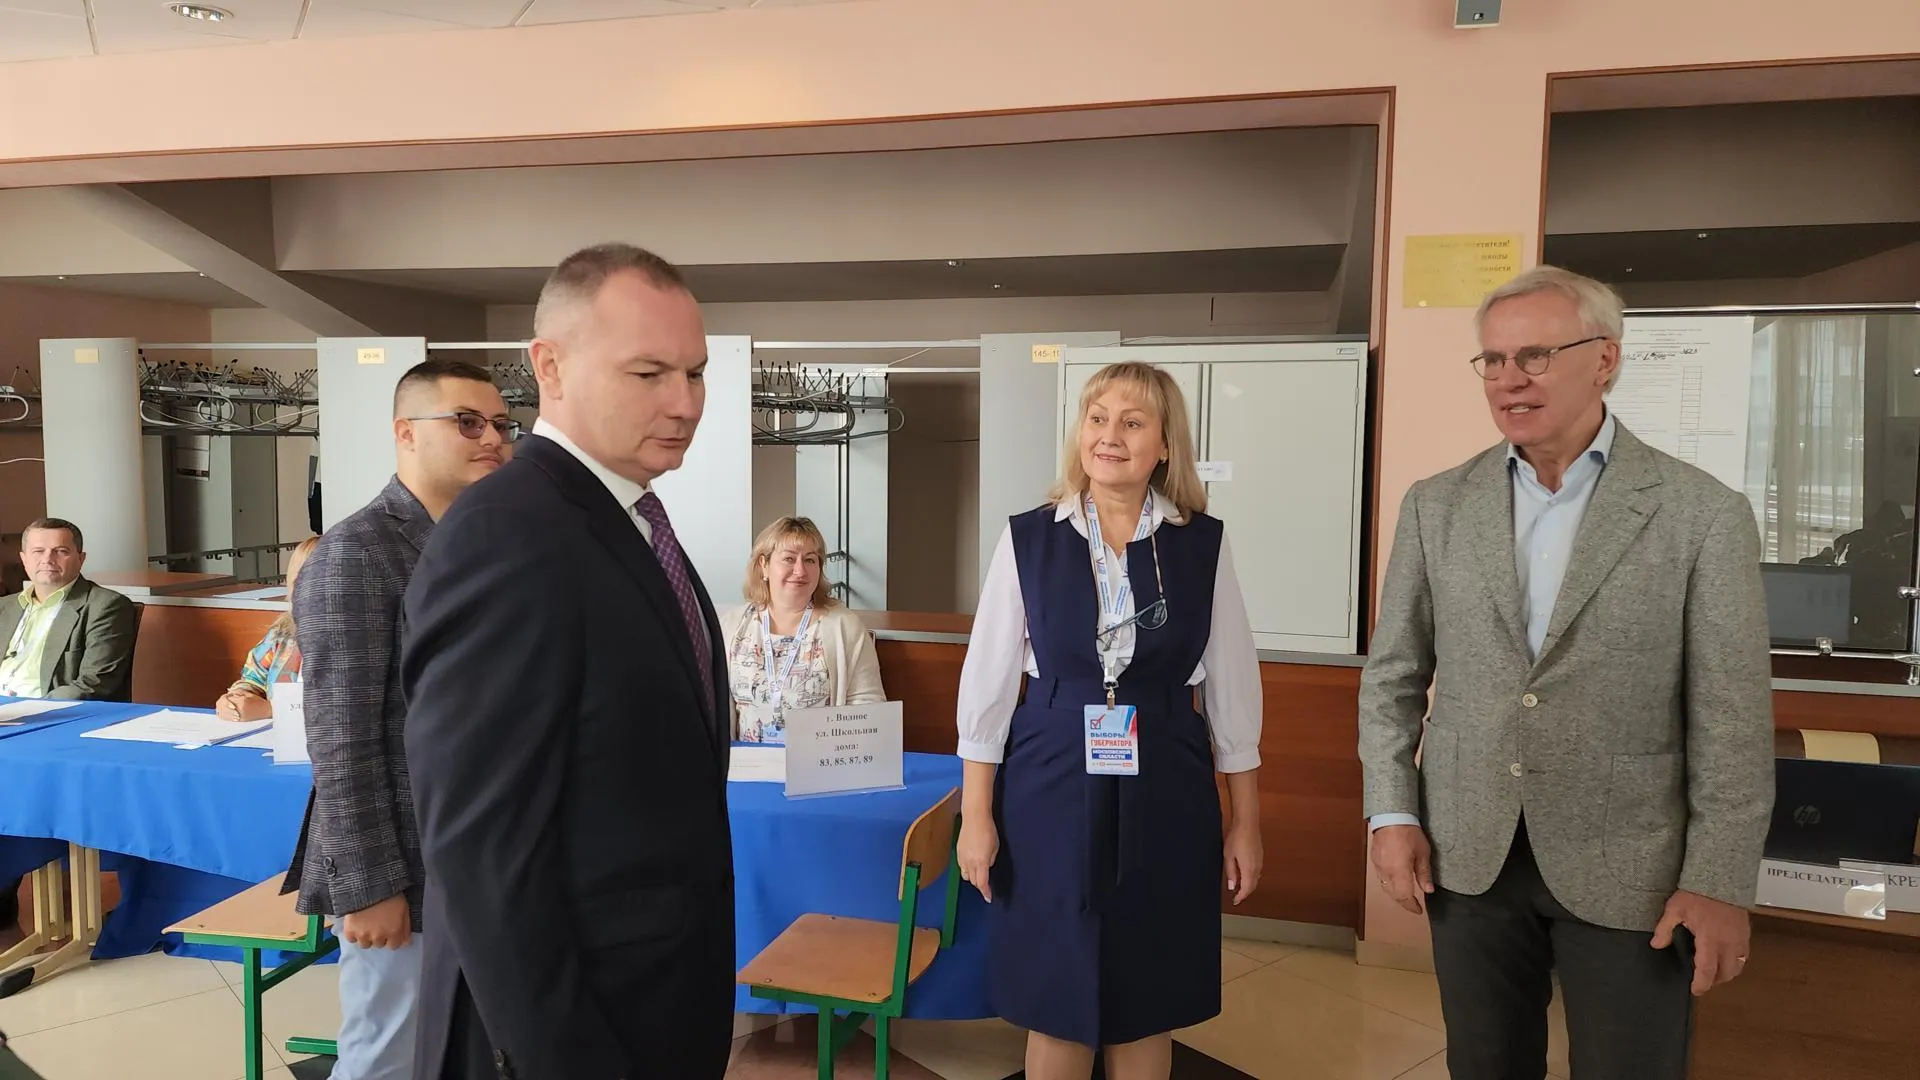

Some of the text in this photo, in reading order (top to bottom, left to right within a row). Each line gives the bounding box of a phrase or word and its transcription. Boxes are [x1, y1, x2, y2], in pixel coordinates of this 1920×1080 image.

[836, 712, 868, 723] Видное
[815, 726, 878, 740] ул. Школьная
[834, 743, 859, 752] дома:
[1090, 739, 1133, 747] ГУБЕРНАТОРА
[819, 754, 873, 767] 83, 85, 87, 89
